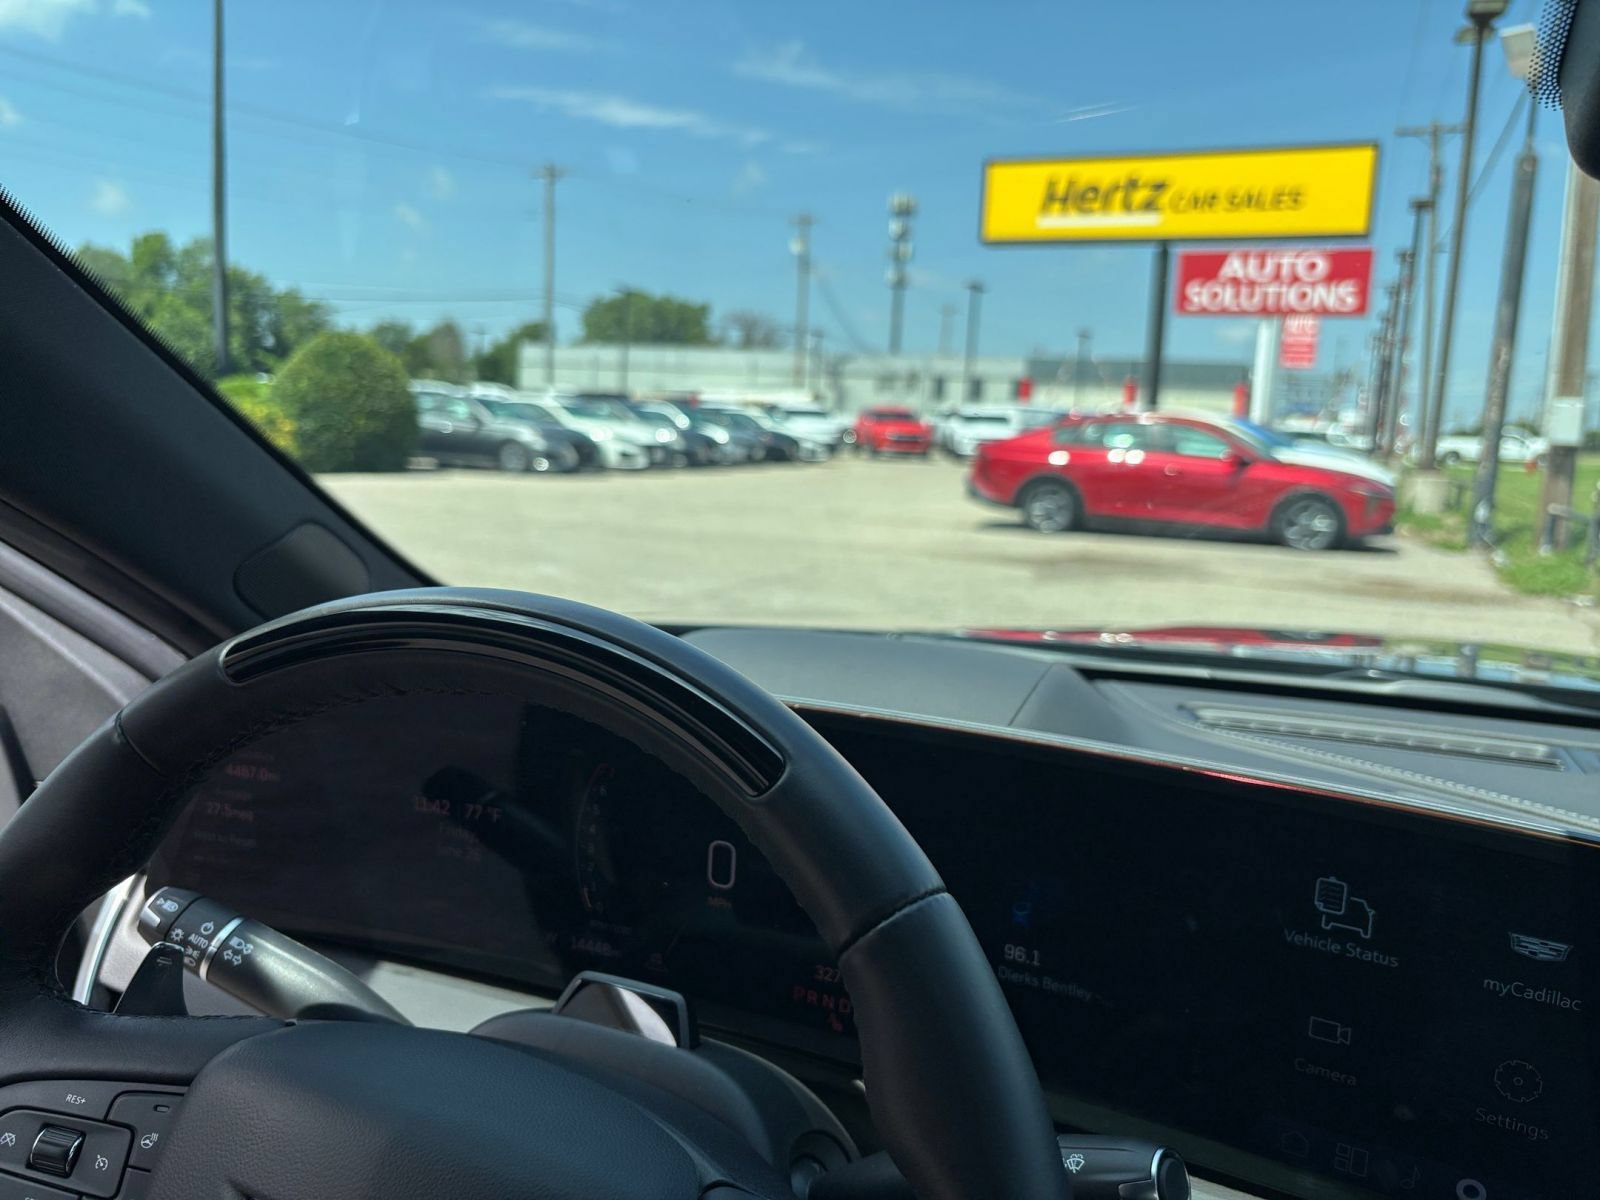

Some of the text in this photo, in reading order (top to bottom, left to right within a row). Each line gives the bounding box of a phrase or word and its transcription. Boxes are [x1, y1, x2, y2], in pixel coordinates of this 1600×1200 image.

[1042, 174, 1309, 214] Hertz CAR SALES
[1217, 251, 1331, 283] AUTO
[1183, 281, 1360, 314] SOLUTIONS
[707, 840, 737, 889] 0
[187, 933, 209, 949] AUTO
[1004, 943, 1041, 967] 96.1
[1283, 927, 1400, 968] Vehicle Status
[1042, 975, 1093, 1002] Bentley
[1482, 977, 1584, 1012] myCadillac
[1293, 1057, 1359, 1087] Camera
[65, 1093, 87, 1105] RES+
[1474, 1107, 1550, 1141] Settings
